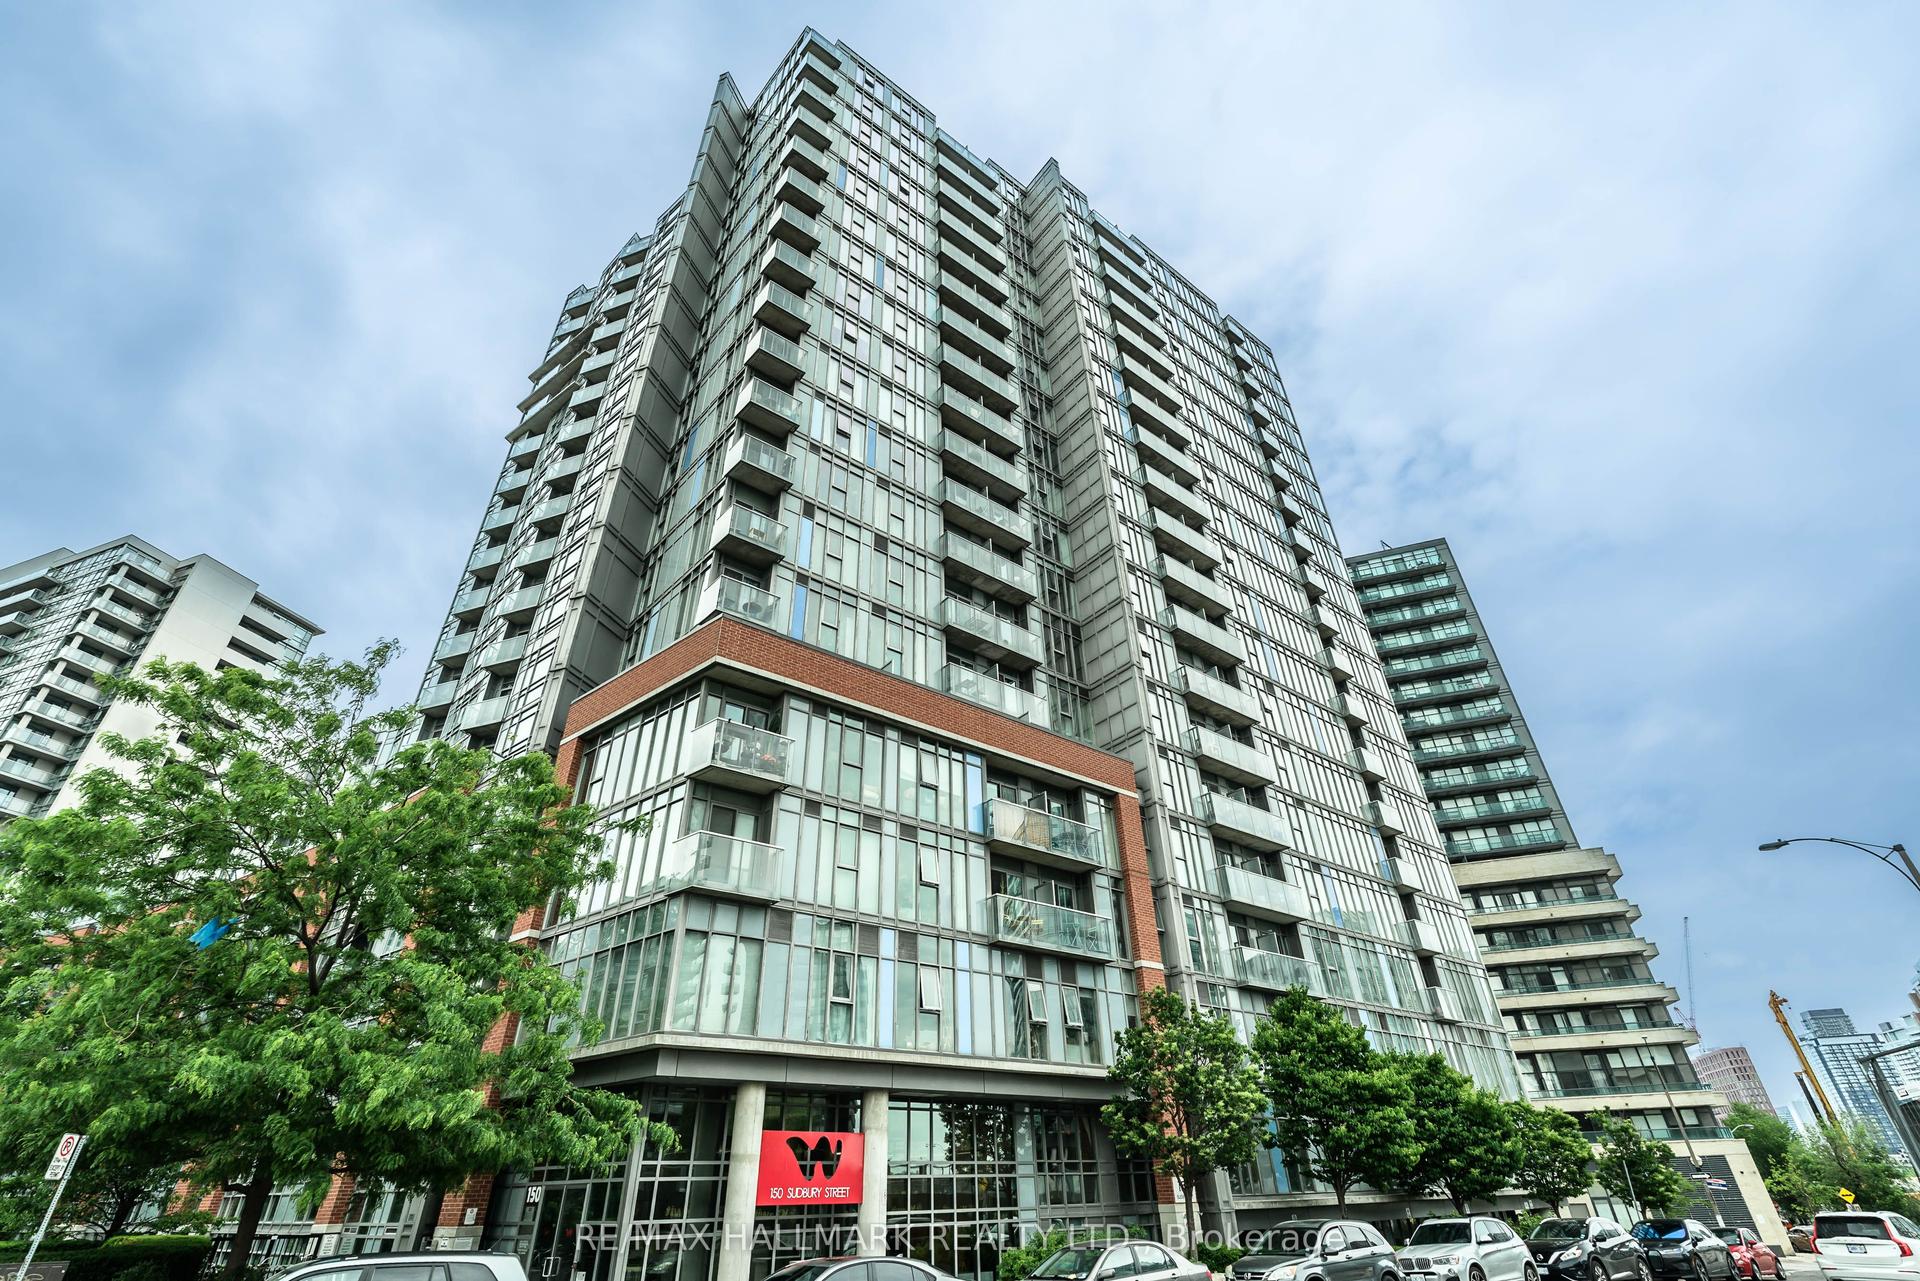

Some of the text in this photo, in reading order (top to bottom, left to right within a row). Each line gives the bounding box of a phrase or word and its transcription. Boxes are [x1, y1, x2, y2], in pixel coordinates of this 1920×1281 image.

[526, 1186, 542, 1203] 150
[770, 1186, 850, 1199] 150 SUDBURY STREET
